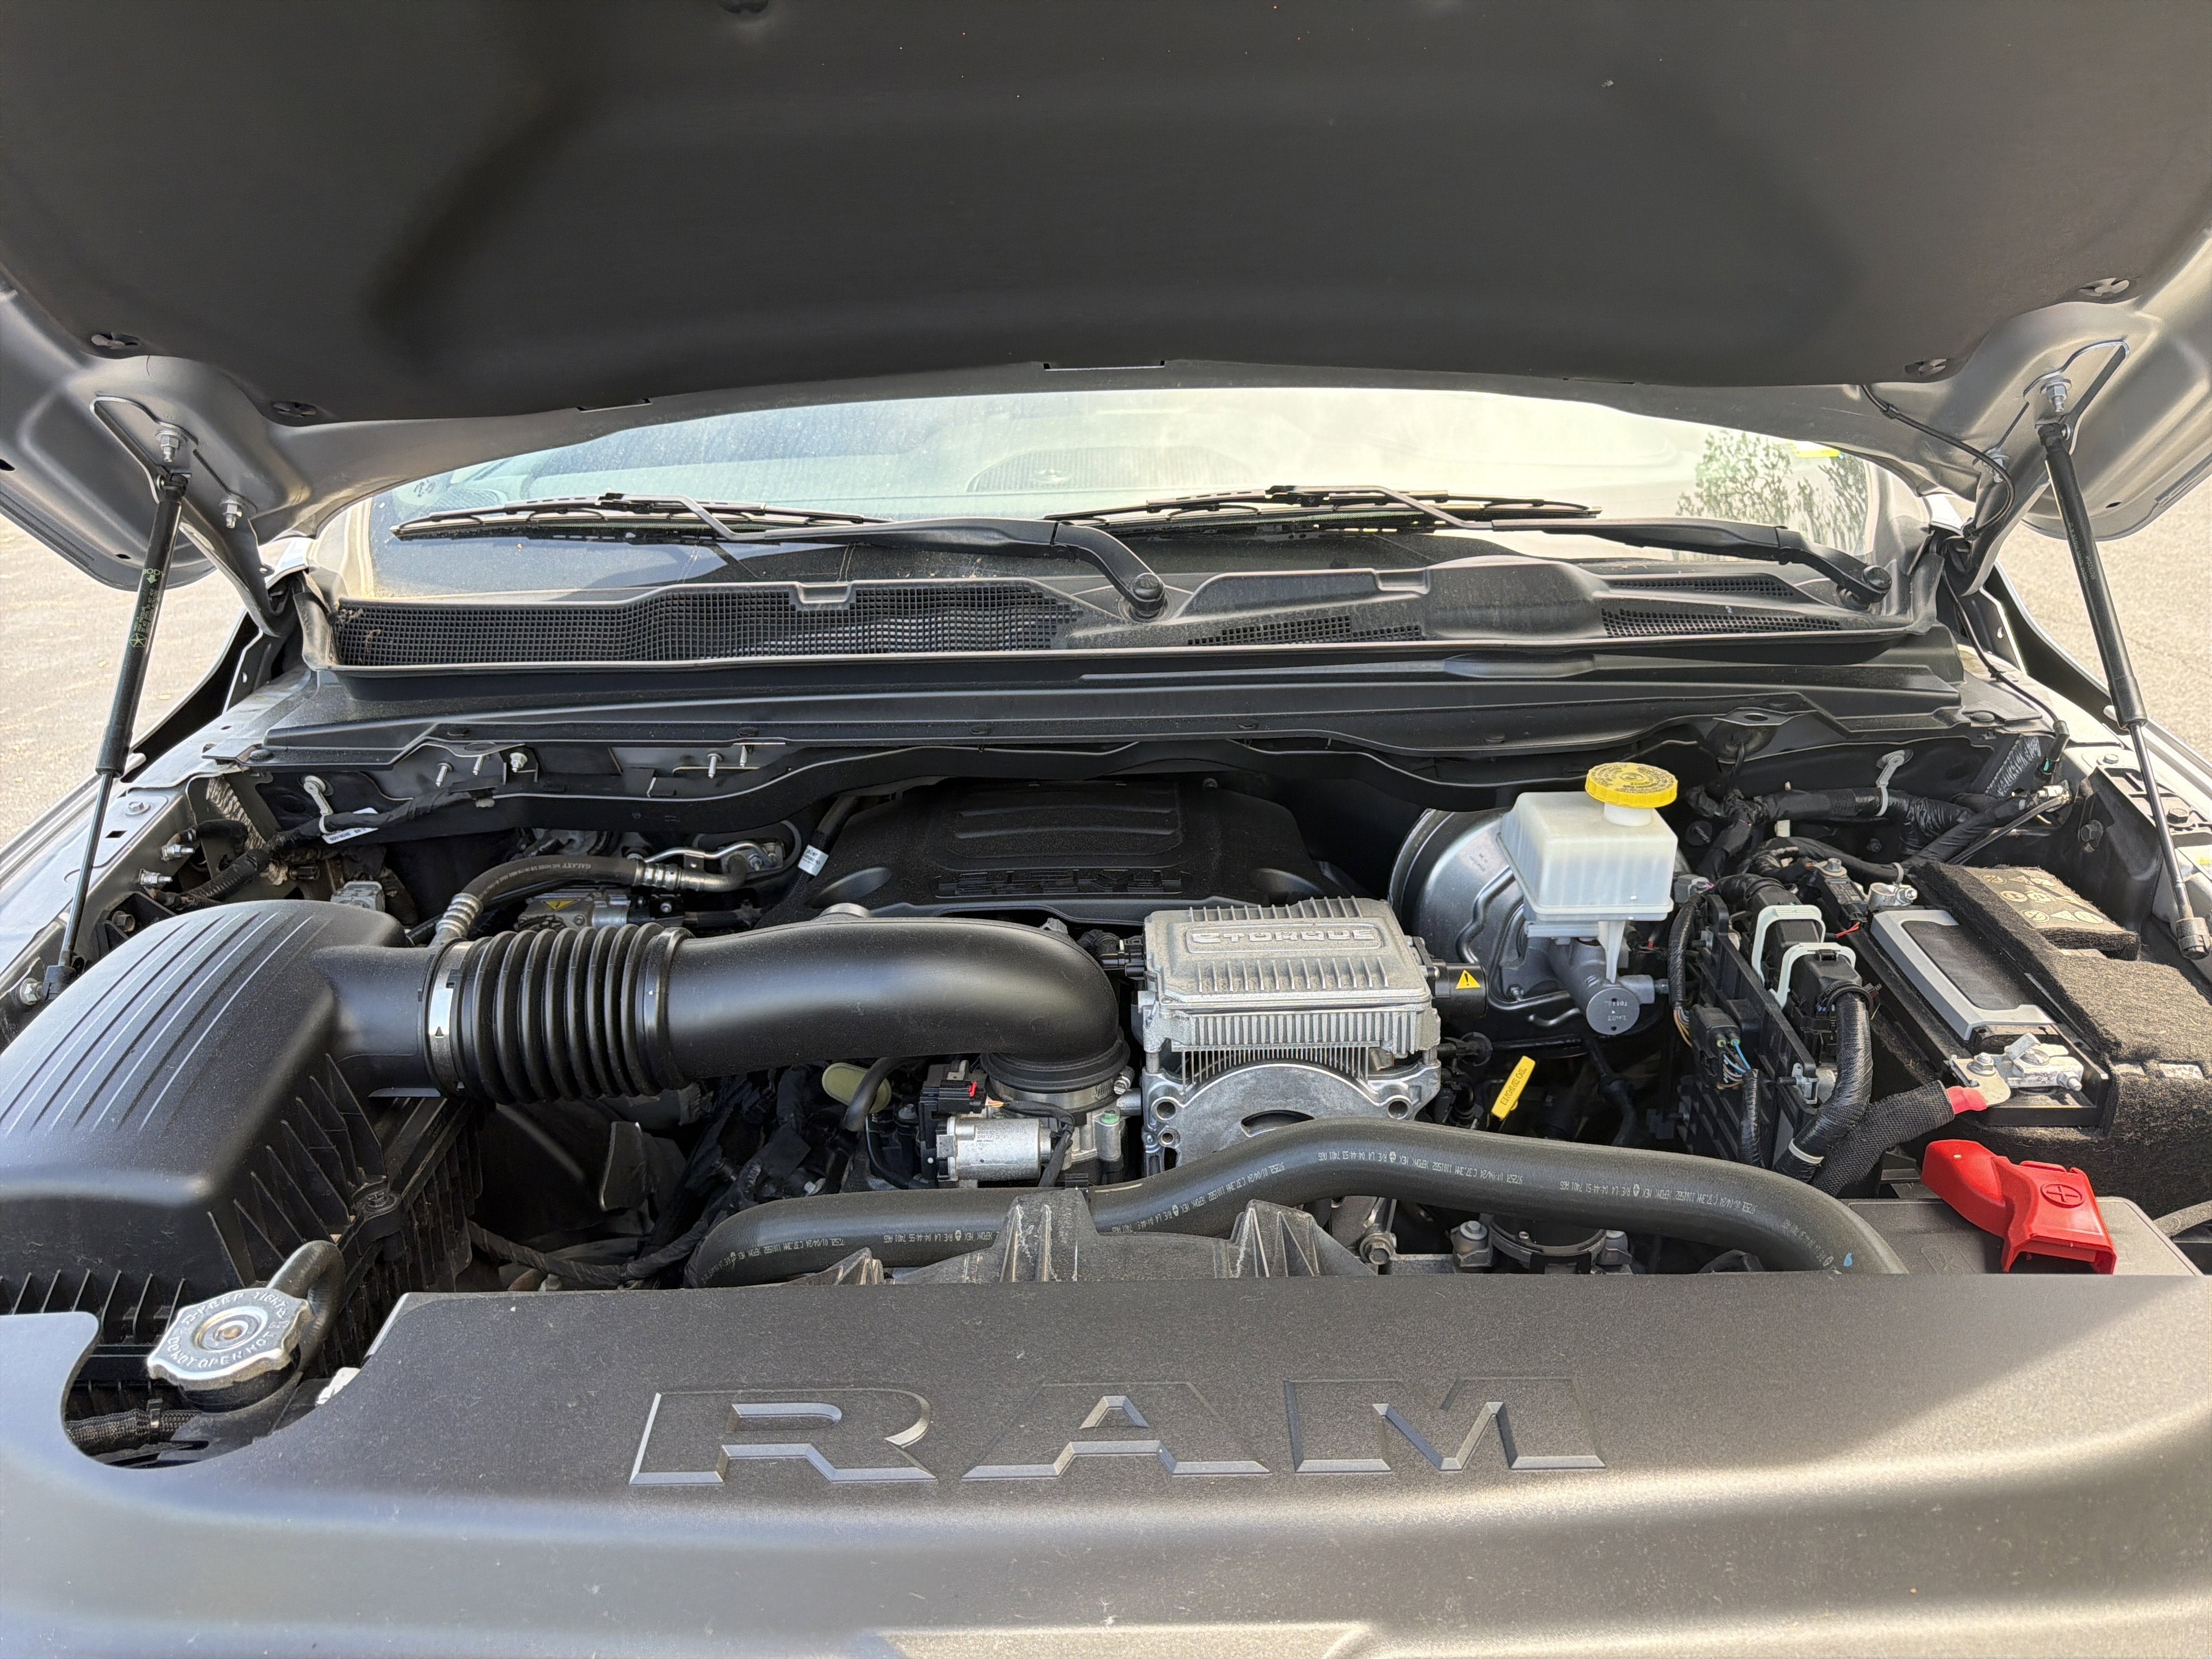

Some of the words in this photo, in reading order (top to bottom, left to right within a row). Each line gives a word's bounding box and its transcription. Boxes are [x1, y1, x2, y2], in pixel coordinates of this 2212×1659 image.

[142, 568, 166, 578] BODY
[1499, 1077, 1520, 1106] ENGINE
[1515, 1067, 1528, 1080] OIL
[1329, 1152, 1340, 1160] 7401
[1342, 1151, 1365, 1160] 04:44:53
[1247, 1167, 1267, 1183] 01/04/24
[806, 1239, 828, 1248] 01/04/24
[895, 1234, 906, 1243] 7401
[198, 1351, 243, 1368] OPEN
[246, 1331, 274, 1354] HOT
[629, 1377, 1606, 1485] RAM
